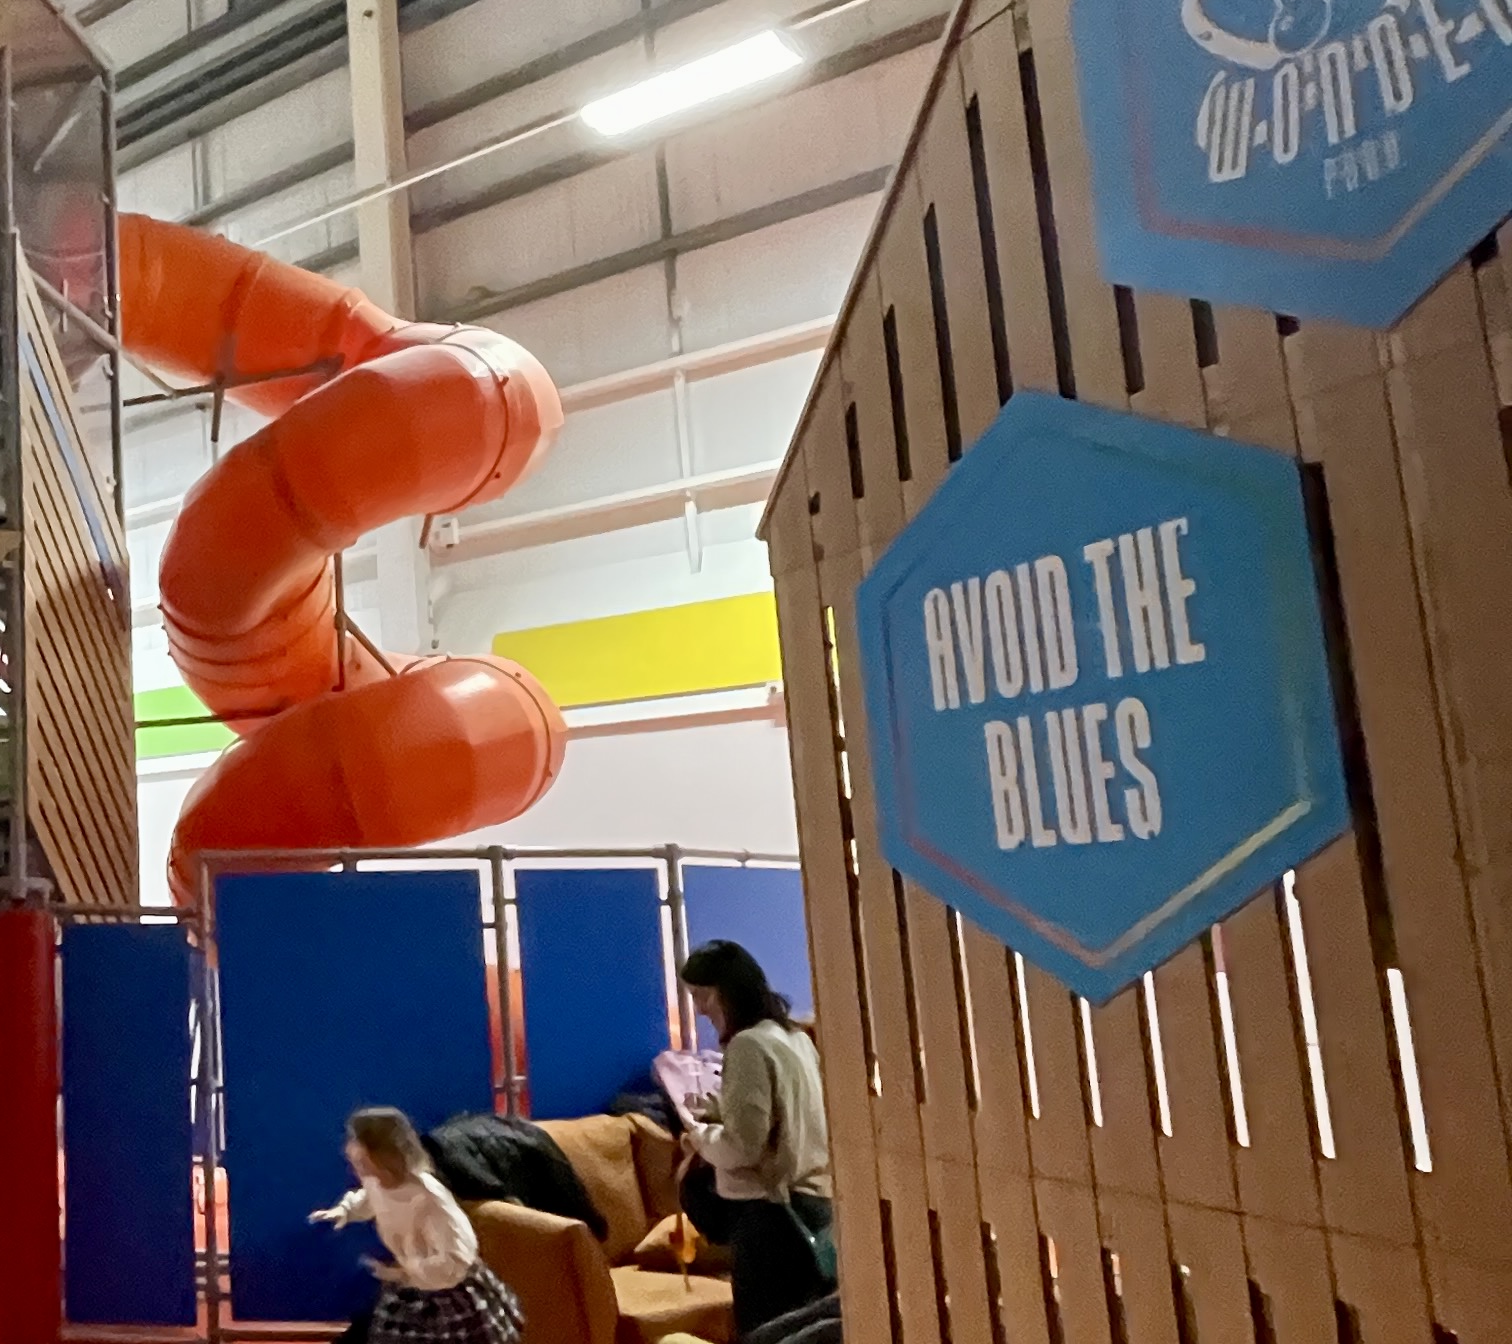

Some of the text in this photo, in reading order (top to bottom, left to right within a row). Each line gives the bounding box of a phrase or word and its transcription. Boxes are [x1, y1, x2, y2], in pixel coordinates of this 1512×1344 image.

[923, 517, 1206, 711] AVOID THE
[983, 697, 1163, 850] BLUES
